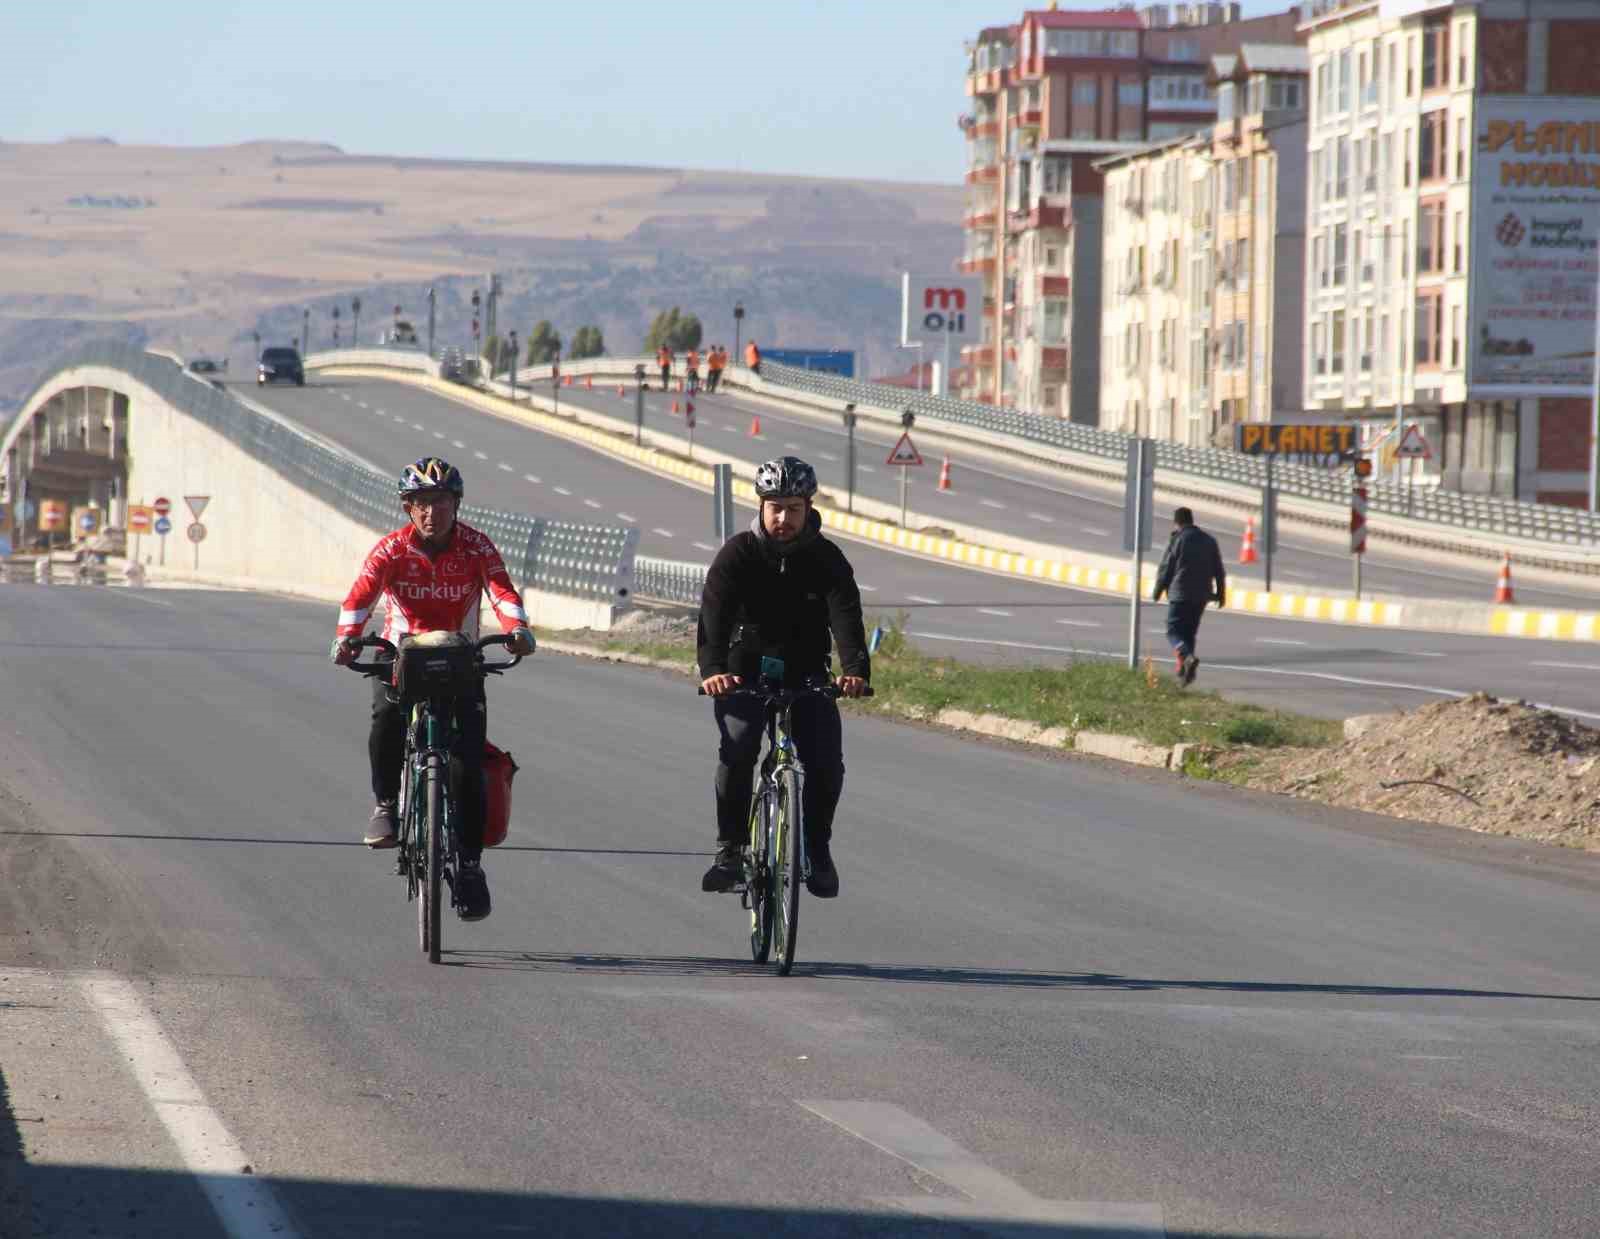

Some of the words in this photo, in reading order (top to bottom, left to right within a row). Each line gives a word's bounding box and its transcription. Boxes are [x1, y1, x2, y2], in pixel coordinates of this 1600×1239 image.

[925, 287, 966, 310] m
[1244, 425, 1352, 452] PLANET
[396, 580, 473, 602] Türkiye
